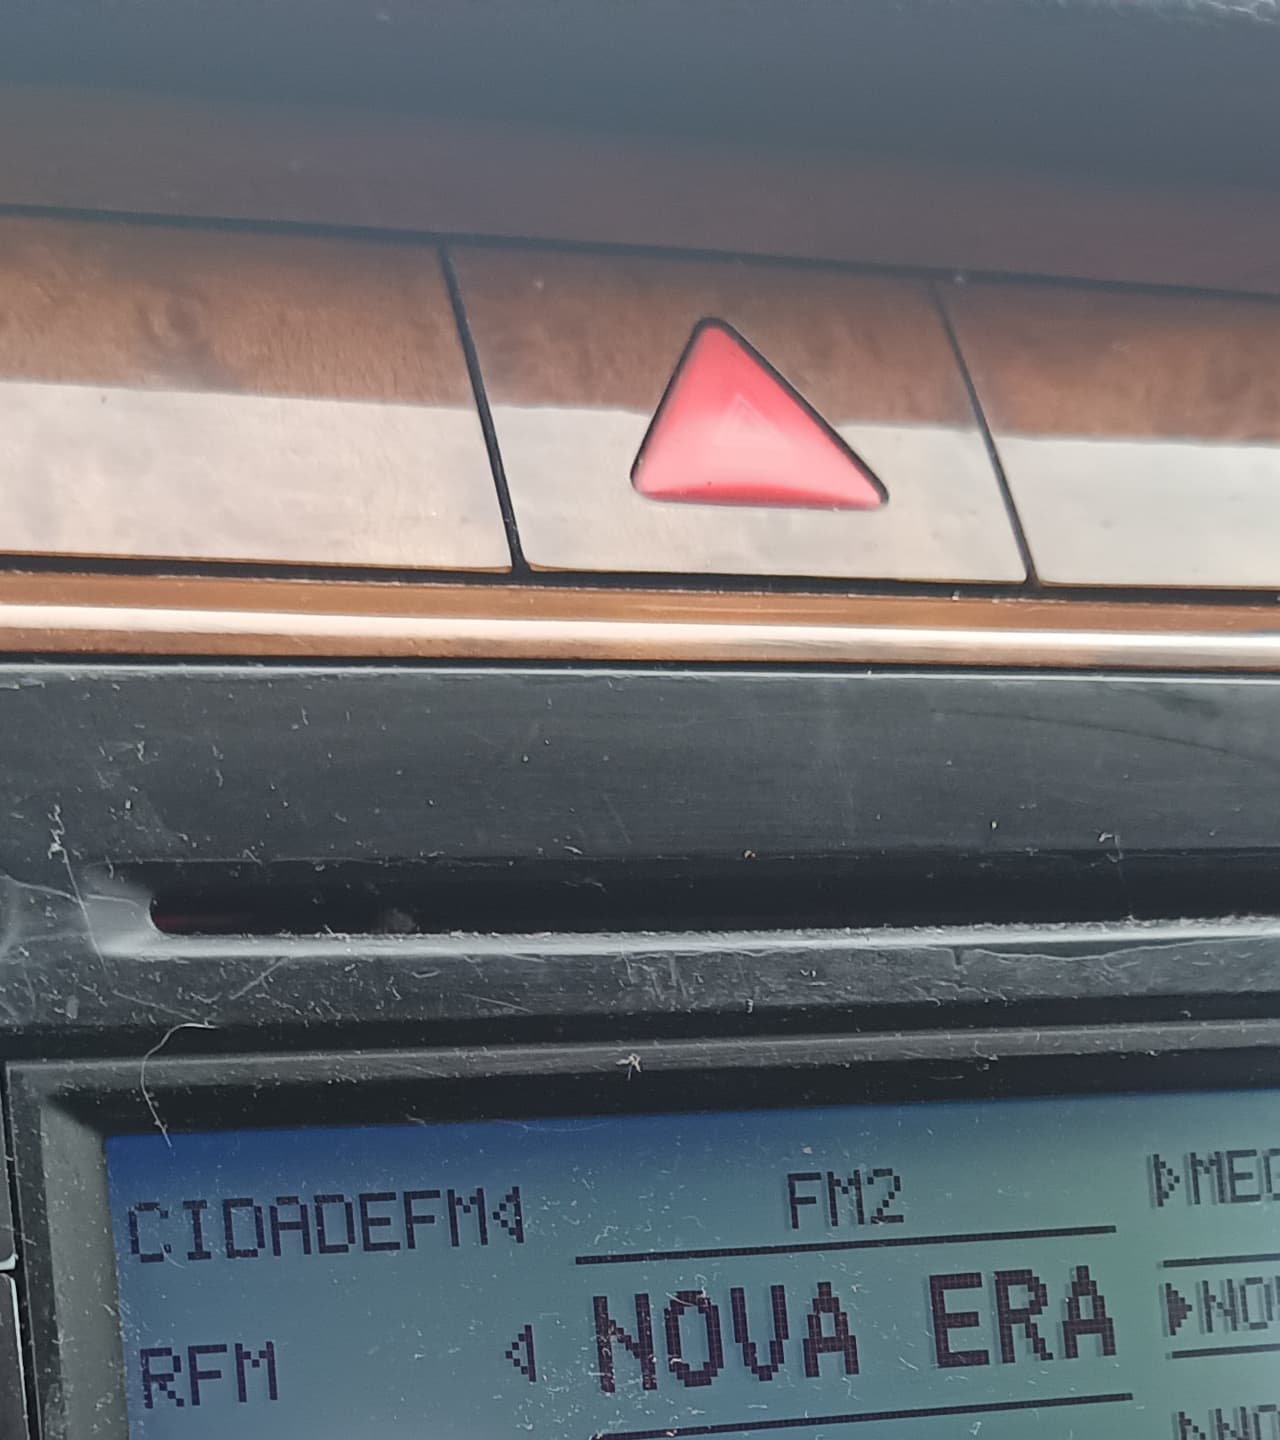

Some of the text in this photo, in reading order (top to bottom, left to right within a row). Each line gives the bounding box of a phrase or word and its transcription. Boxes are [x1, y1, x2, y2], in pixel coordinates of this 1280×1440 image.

[128, 1187, 489, 1263] CIDADEFM
[786, 1167, 906, 1230] FM2
[592, 1265, 1117, 1393] NOVA ERA
[140, 1341, 278, 1409] RFM
